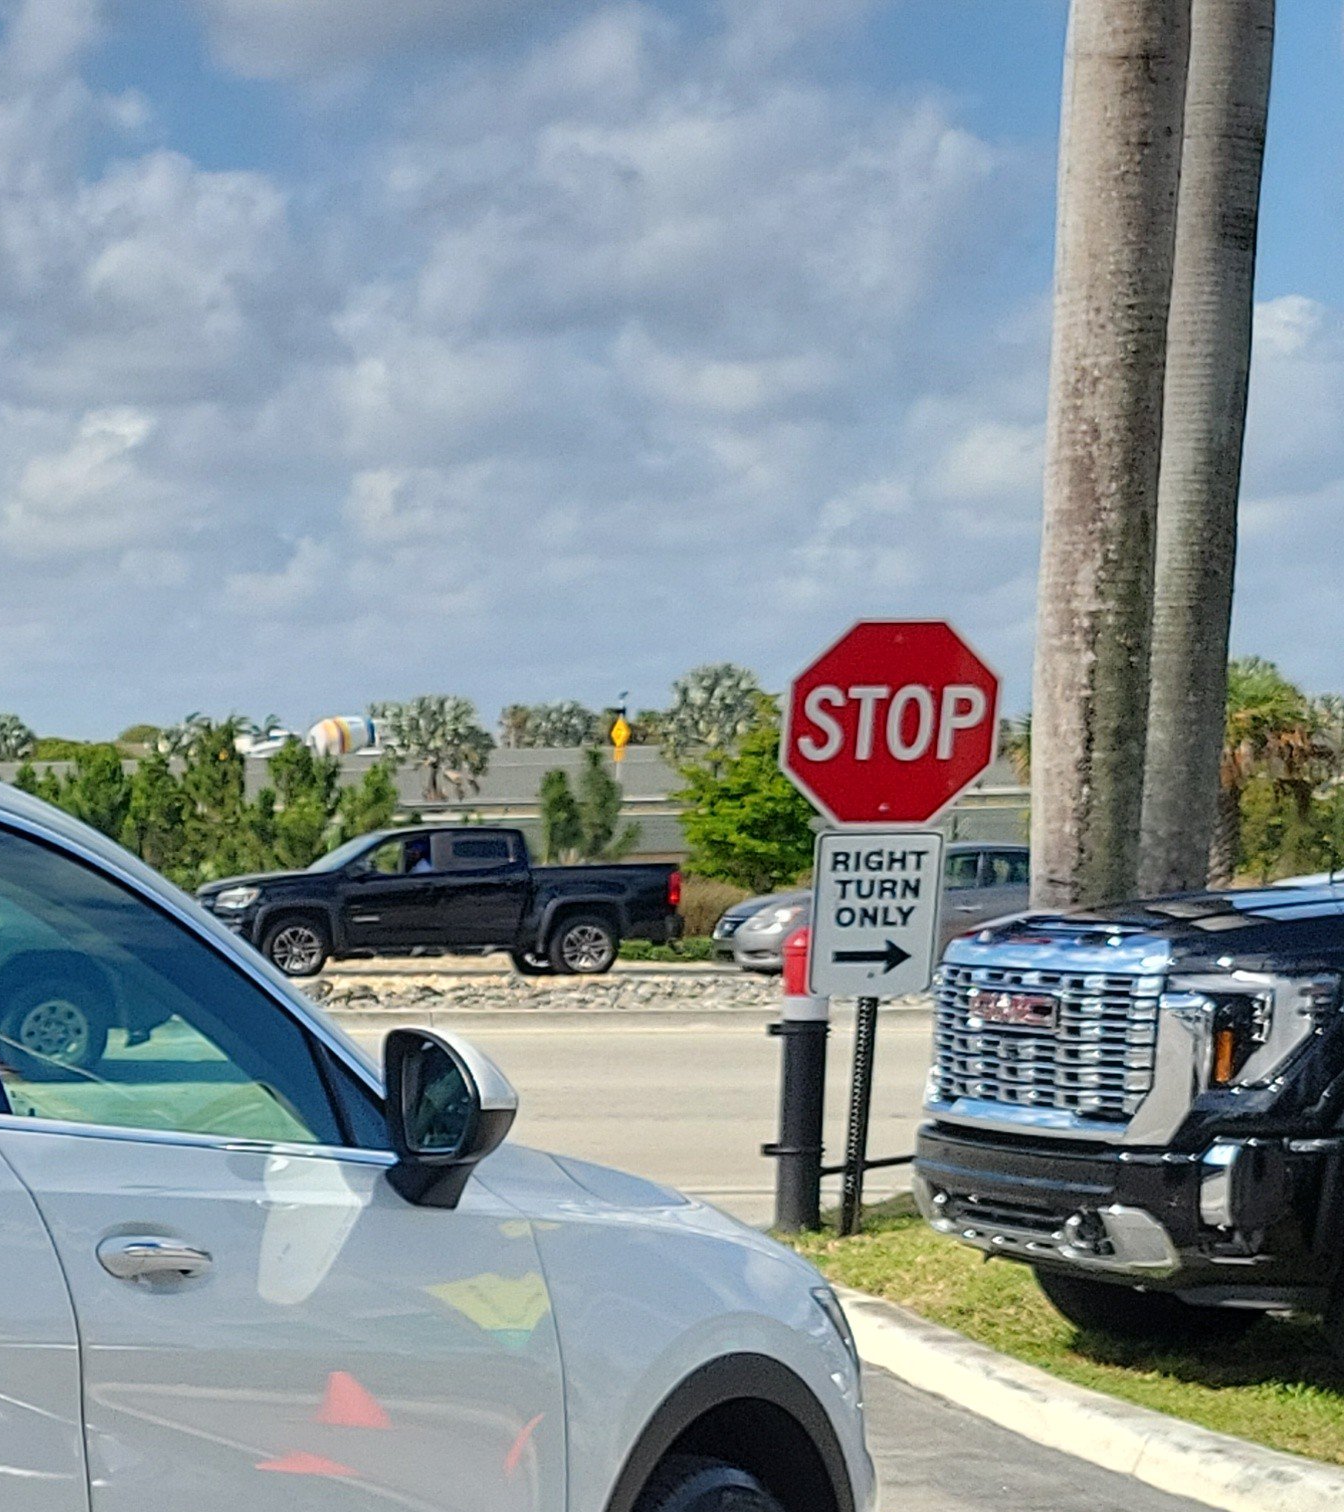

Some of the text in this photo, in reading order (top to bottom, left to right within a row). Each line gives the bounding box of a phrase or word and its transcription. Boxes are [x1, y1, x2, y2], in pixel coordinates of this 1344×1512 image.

[797, 683, 988, 763] STOP
[830, 848, 930, 873] RIGHT
[834, 879, 922, 900] TURN
[834, 905, 916, 929] ONLY
